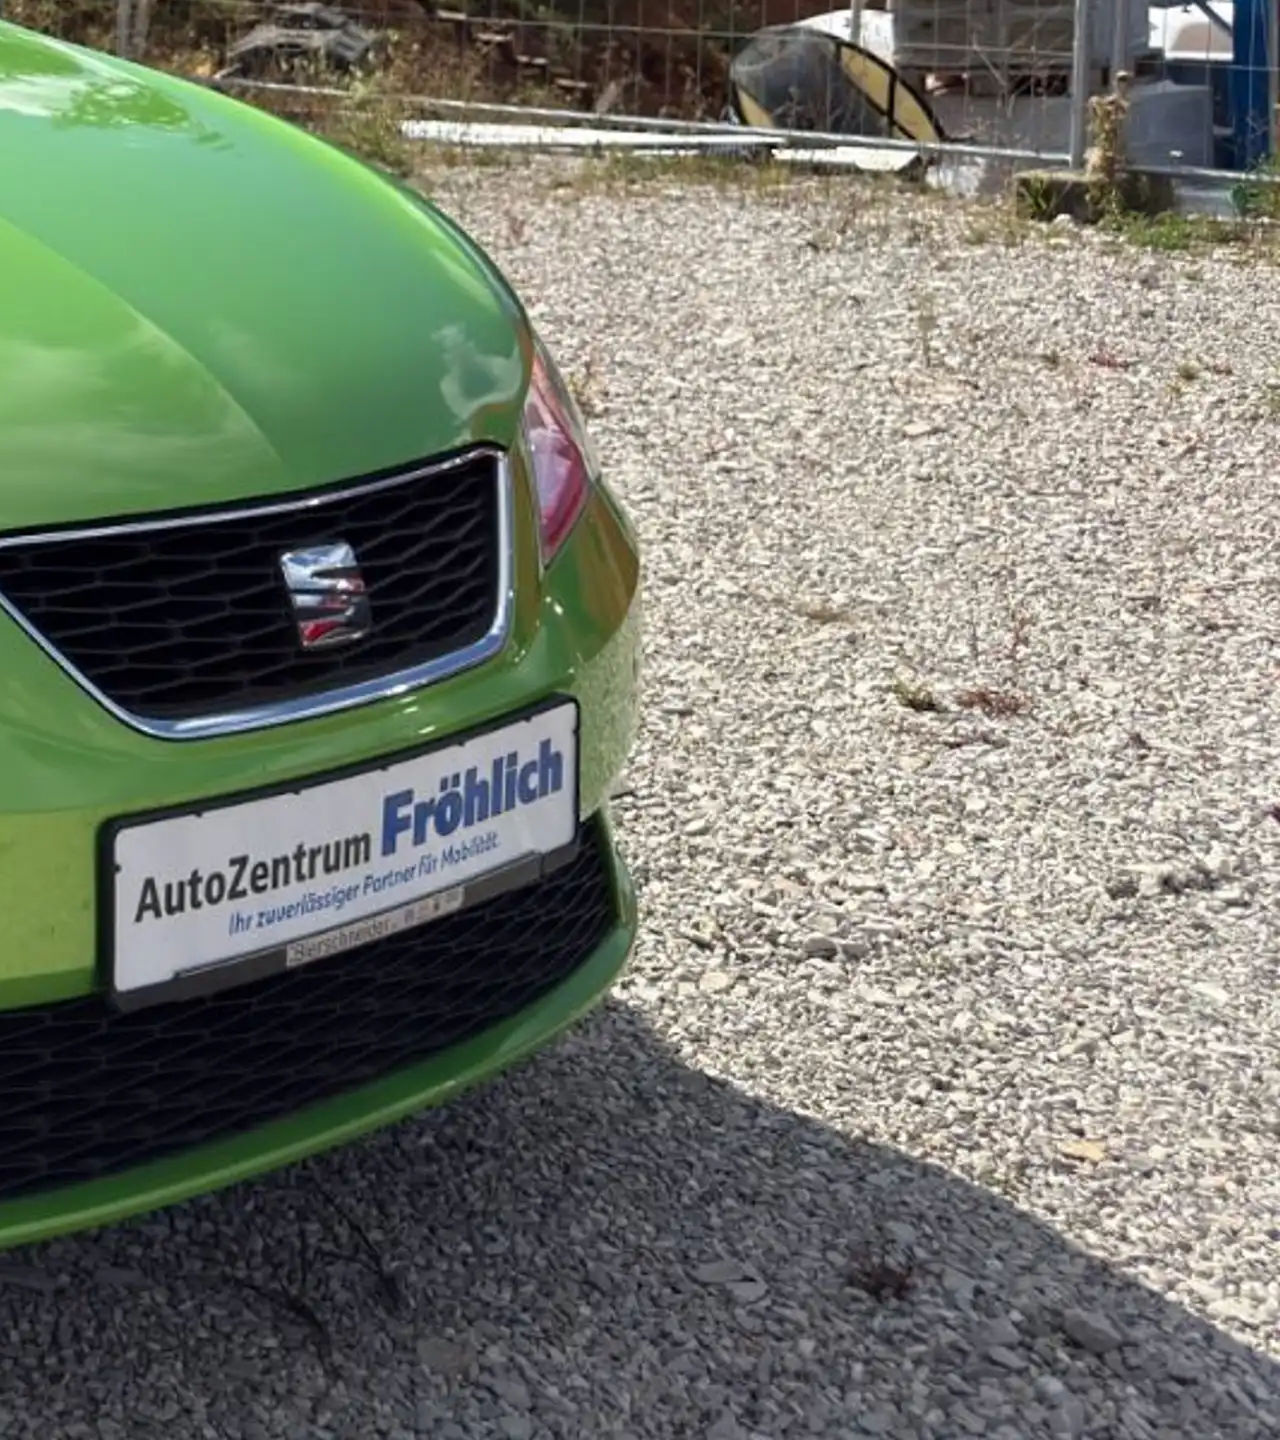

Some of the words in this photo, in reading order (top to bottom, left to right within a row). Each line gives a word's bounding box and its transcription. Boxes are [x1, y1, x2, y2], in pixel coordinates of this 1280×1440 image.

[134, 831, 371, 924] AutoZentrum
[381, 737, 564, 858] Fröhlich
[228, 912, 252, 937] Ihr
[256, 882, 360, 929] zuverlässiger
[363, 864, 416, 897] Partner
[417, 853, 438, 884] für
